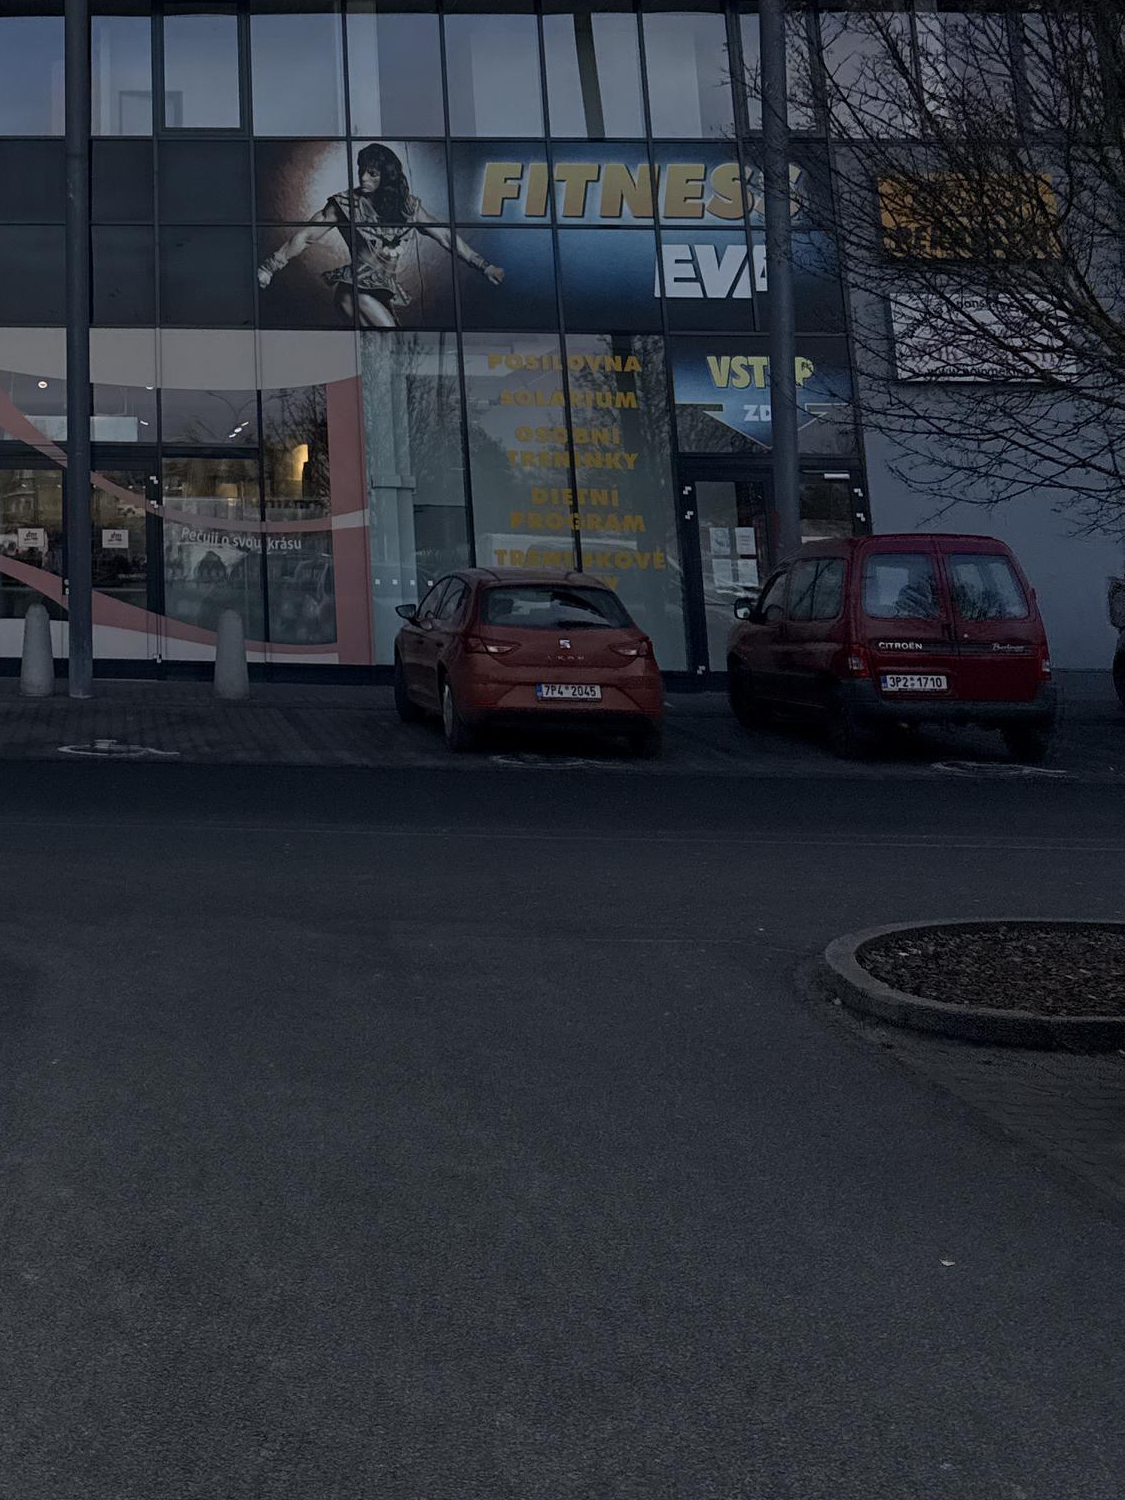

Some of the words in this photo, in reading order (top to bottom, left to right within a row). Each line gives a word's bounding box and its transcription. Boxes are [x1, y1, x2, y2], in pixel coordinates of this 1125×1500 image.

[487, 354, 643, 373] POSILOVNA
[707, 356, 814, 389] VSTP
[743, 404, 772, 422] ZD
[509, 511, 645, 533] PROGRAM
[221, 535, 229, 545] o
[233, 536, 261, 550] svou
[266, 537, 302, 551] krásu
[544, 685, 564, 697] 7P4
[571, 685, 597, 697] 2045
[889, 676, 909, 689] 3P2
[916, 676, 943, 689] 1710
